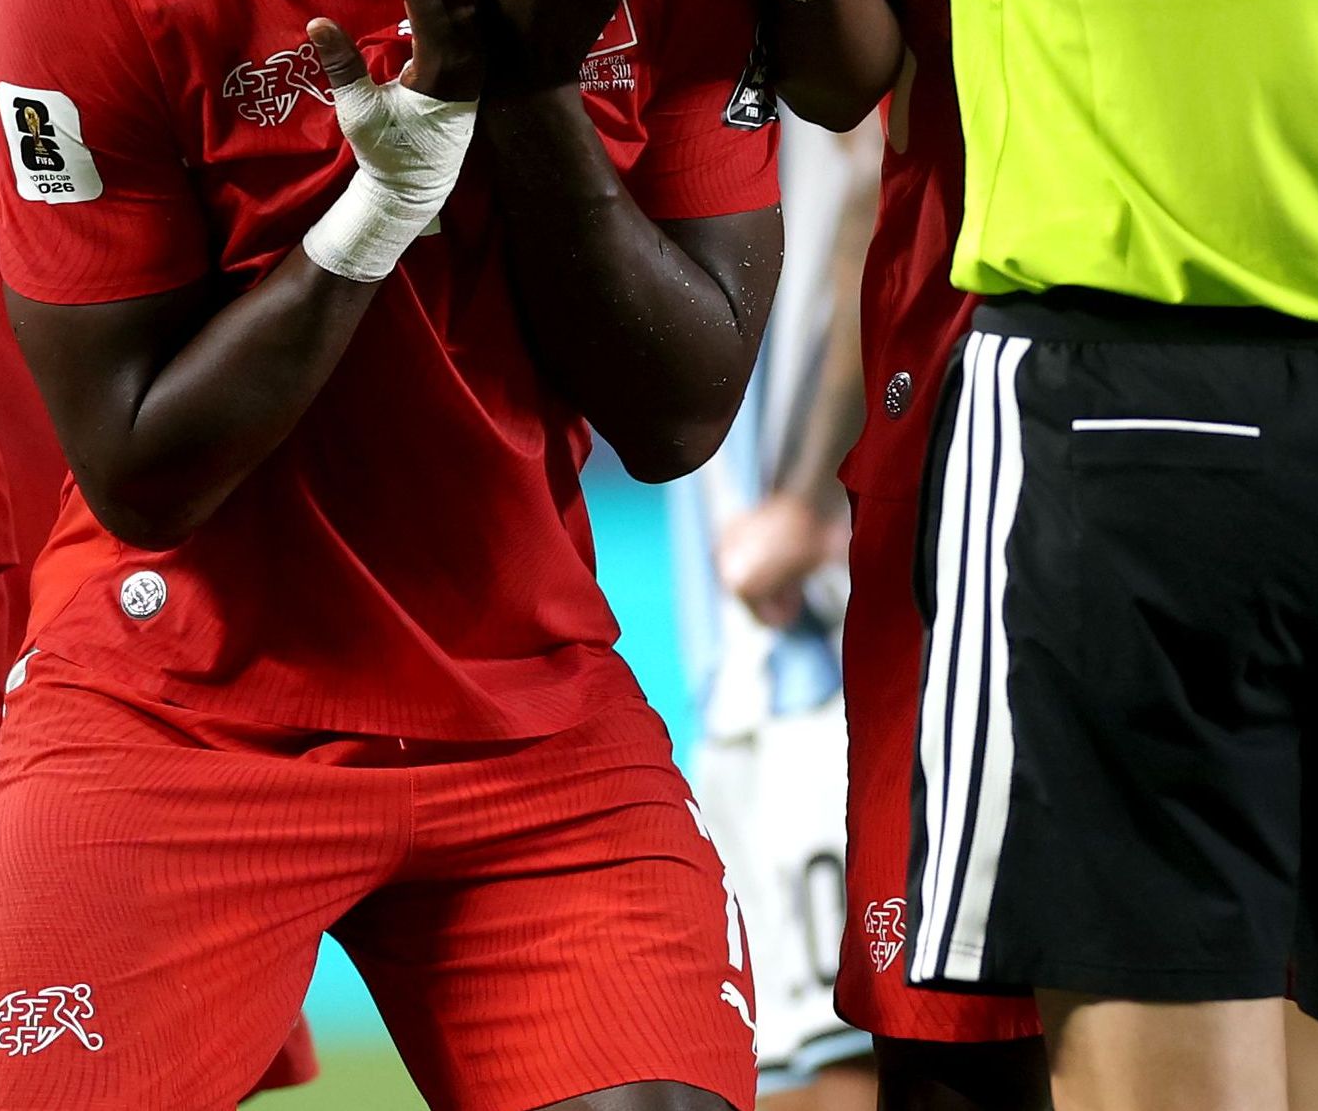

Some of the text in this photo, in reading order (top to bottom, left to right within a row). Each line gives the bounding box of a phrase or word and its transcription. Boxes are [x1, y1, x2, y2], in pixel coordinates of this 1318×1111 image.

[35, 155, 55, 167] FIFA
[29, 173, 72, 183] ORLD CUP
[33, 182, 76, 195] 026
